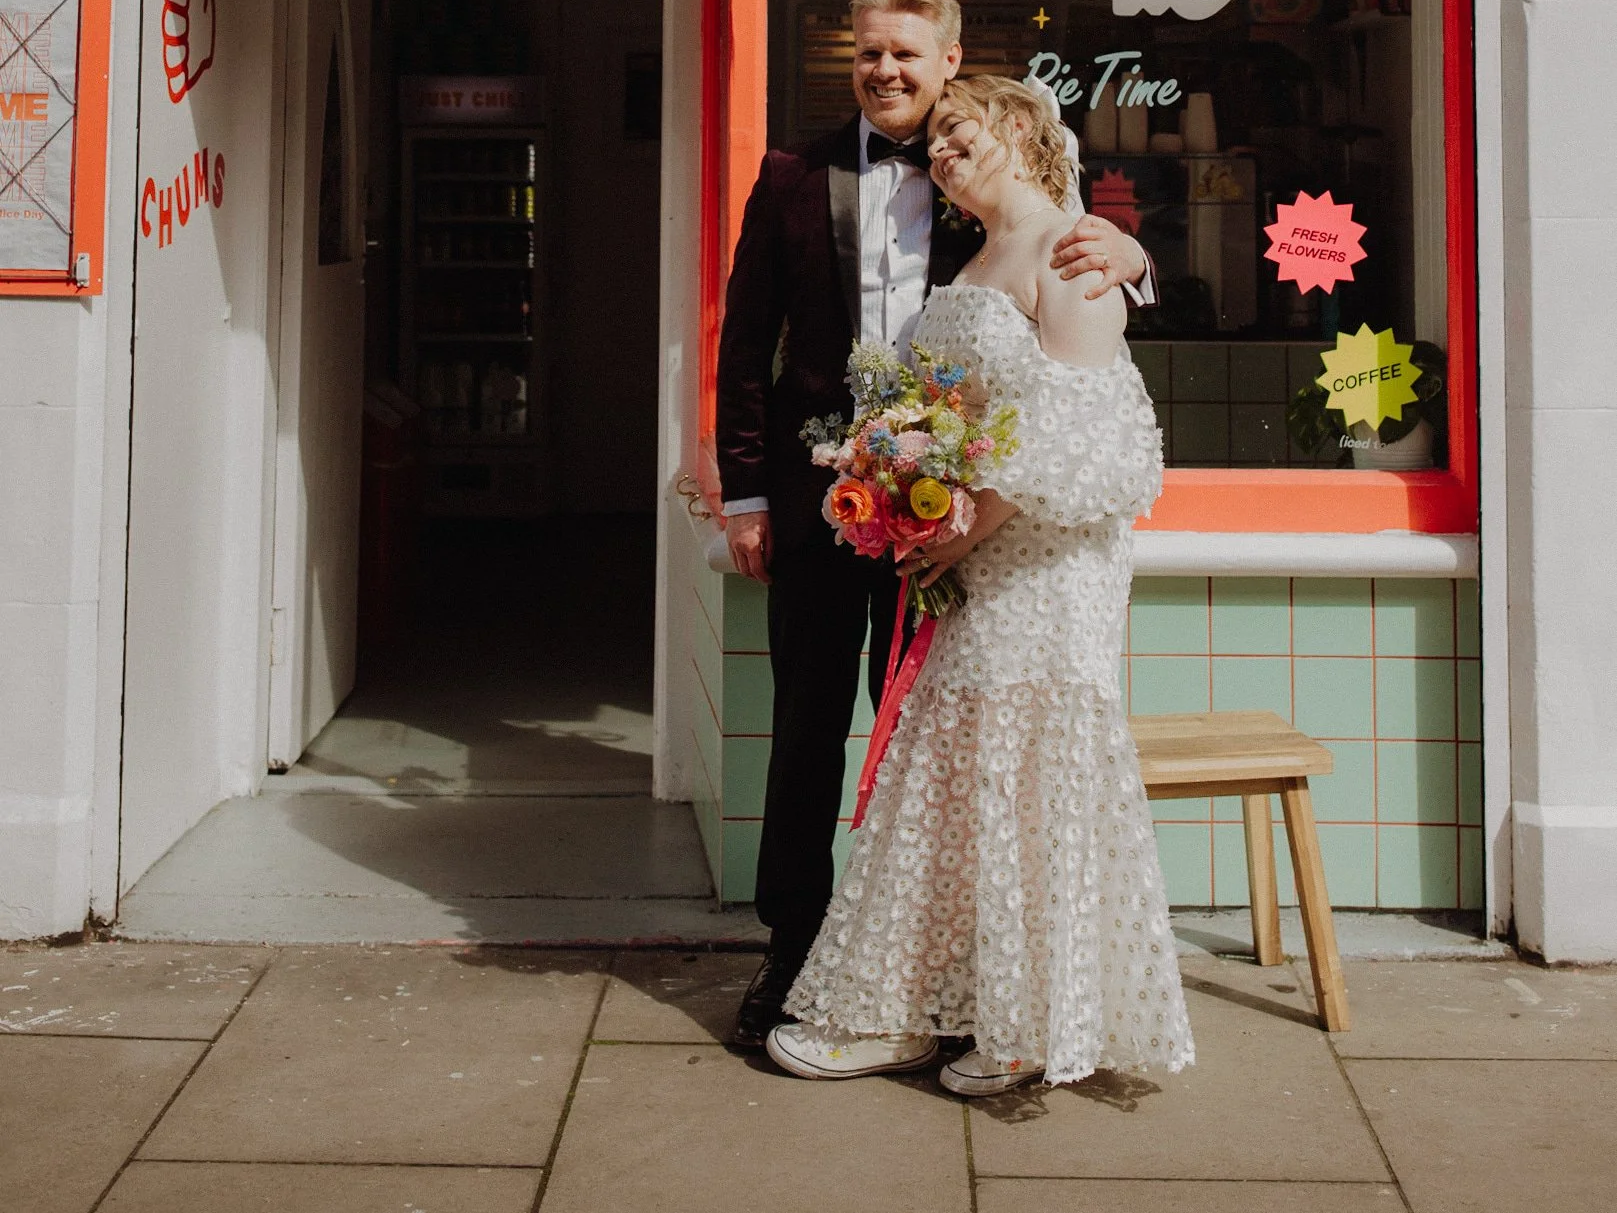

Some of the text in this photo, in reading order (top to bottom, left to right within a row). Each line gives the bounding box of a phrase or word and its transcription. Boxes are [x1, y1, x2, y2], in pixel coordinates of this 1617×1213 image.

[1090, 50, 1182, 110] Time
[141, 147, 225, 249] CHUMS
[1291, 228, 1339, 245] FRESH
[1278, 242, 1347, 263] FLOWERS
[1333, 362, 1402, 393] COFFEE
